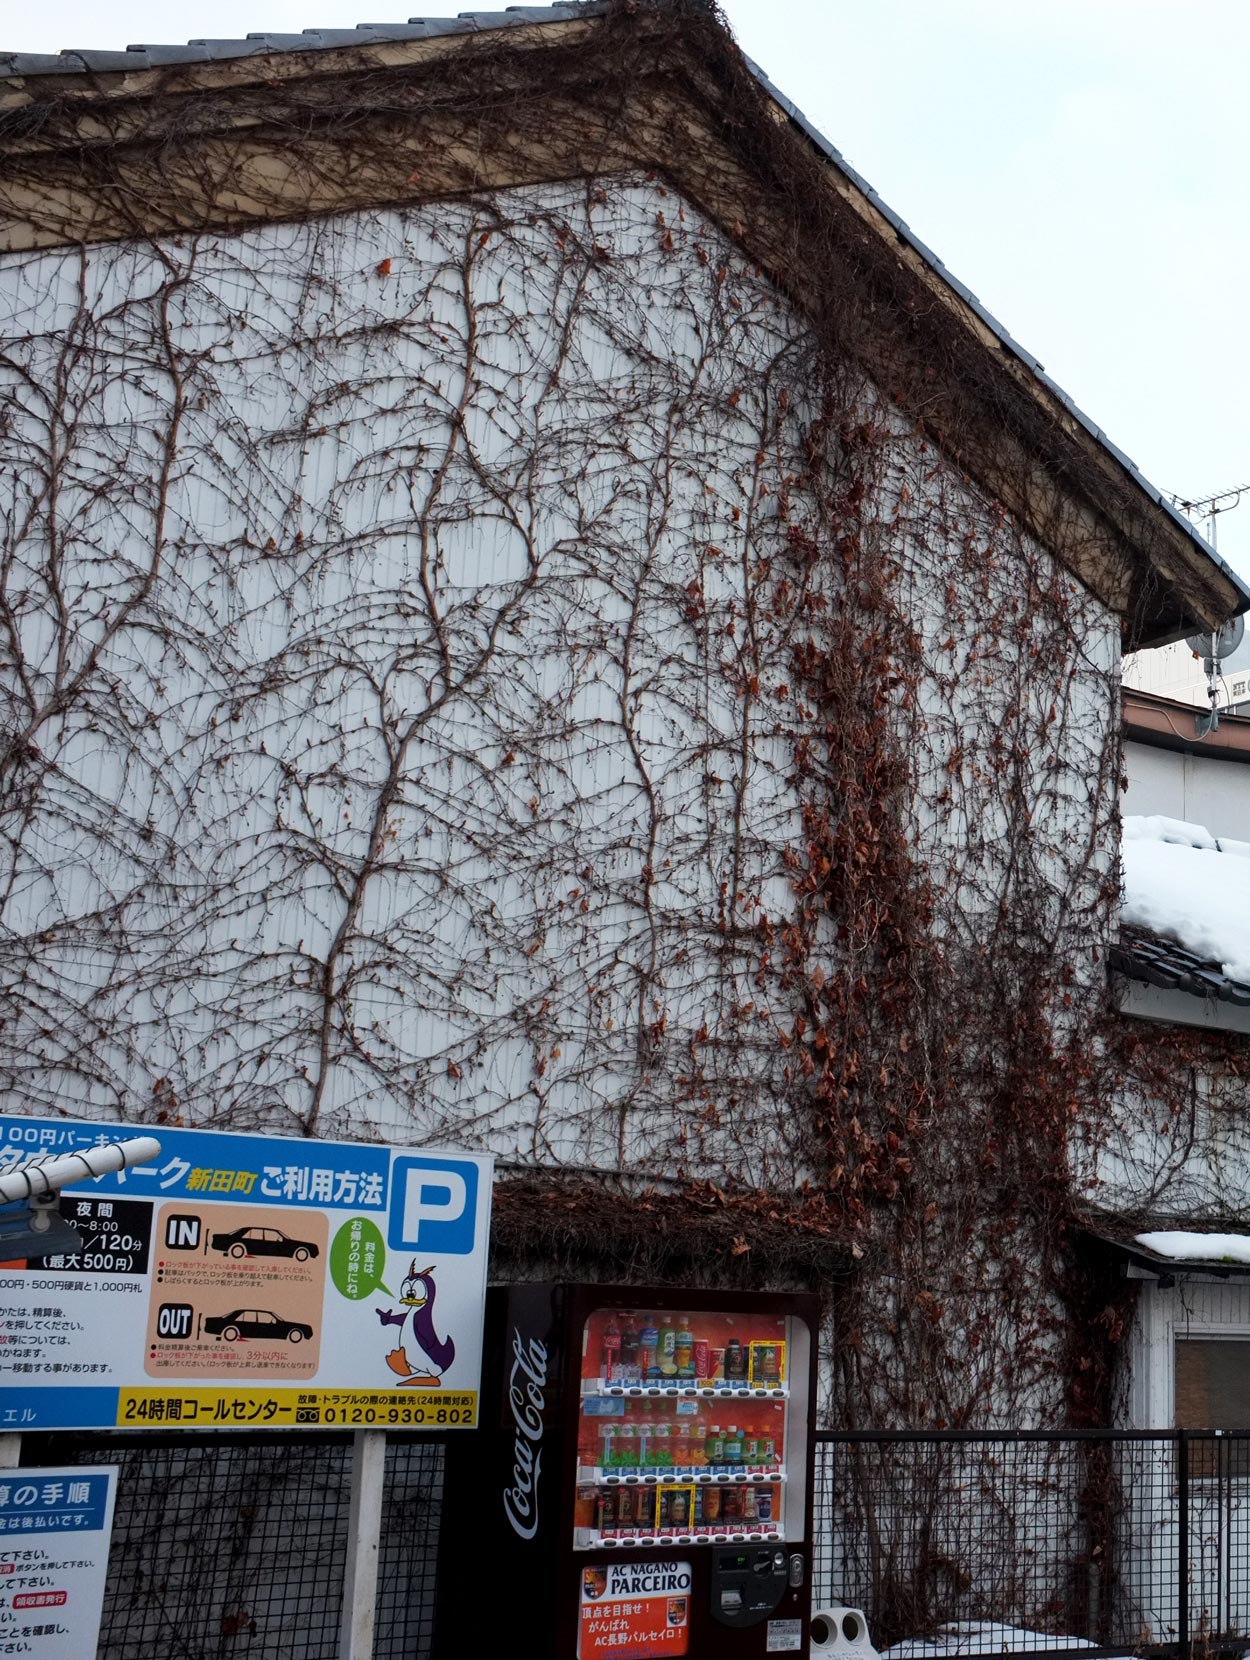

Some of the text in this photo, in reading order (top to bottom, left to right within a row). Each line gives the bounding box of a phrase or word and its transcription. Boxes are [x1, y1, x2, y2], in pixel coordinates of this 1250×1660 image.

[186, 1168, 258, 1194] 新田町
[260, 1165, 383, 1206] ご利用方法
[76, 1202, 114, 1218] 夜間
[402, 1168, 467, 1244] P
[168, 1219, 199, 1247] IN
[42, 1254, 134, 1271] (最大500円)
[159, 1308, 192, 1336] OUT
[0, 1348, 46, 1358] かねます。
[0, 1362, 113, 1374] ー移動する事があります。
[125, 1398, 292, 1421] 24時間コールセンター
[325, 1407, 473, 1424] 0120-930-802
[503, 1326, 549, 1540] Coca-Cola
[612, 1562, 678, 1577] AC NAGANO
[611, 1574, 691, 1595] PARCEIRO
